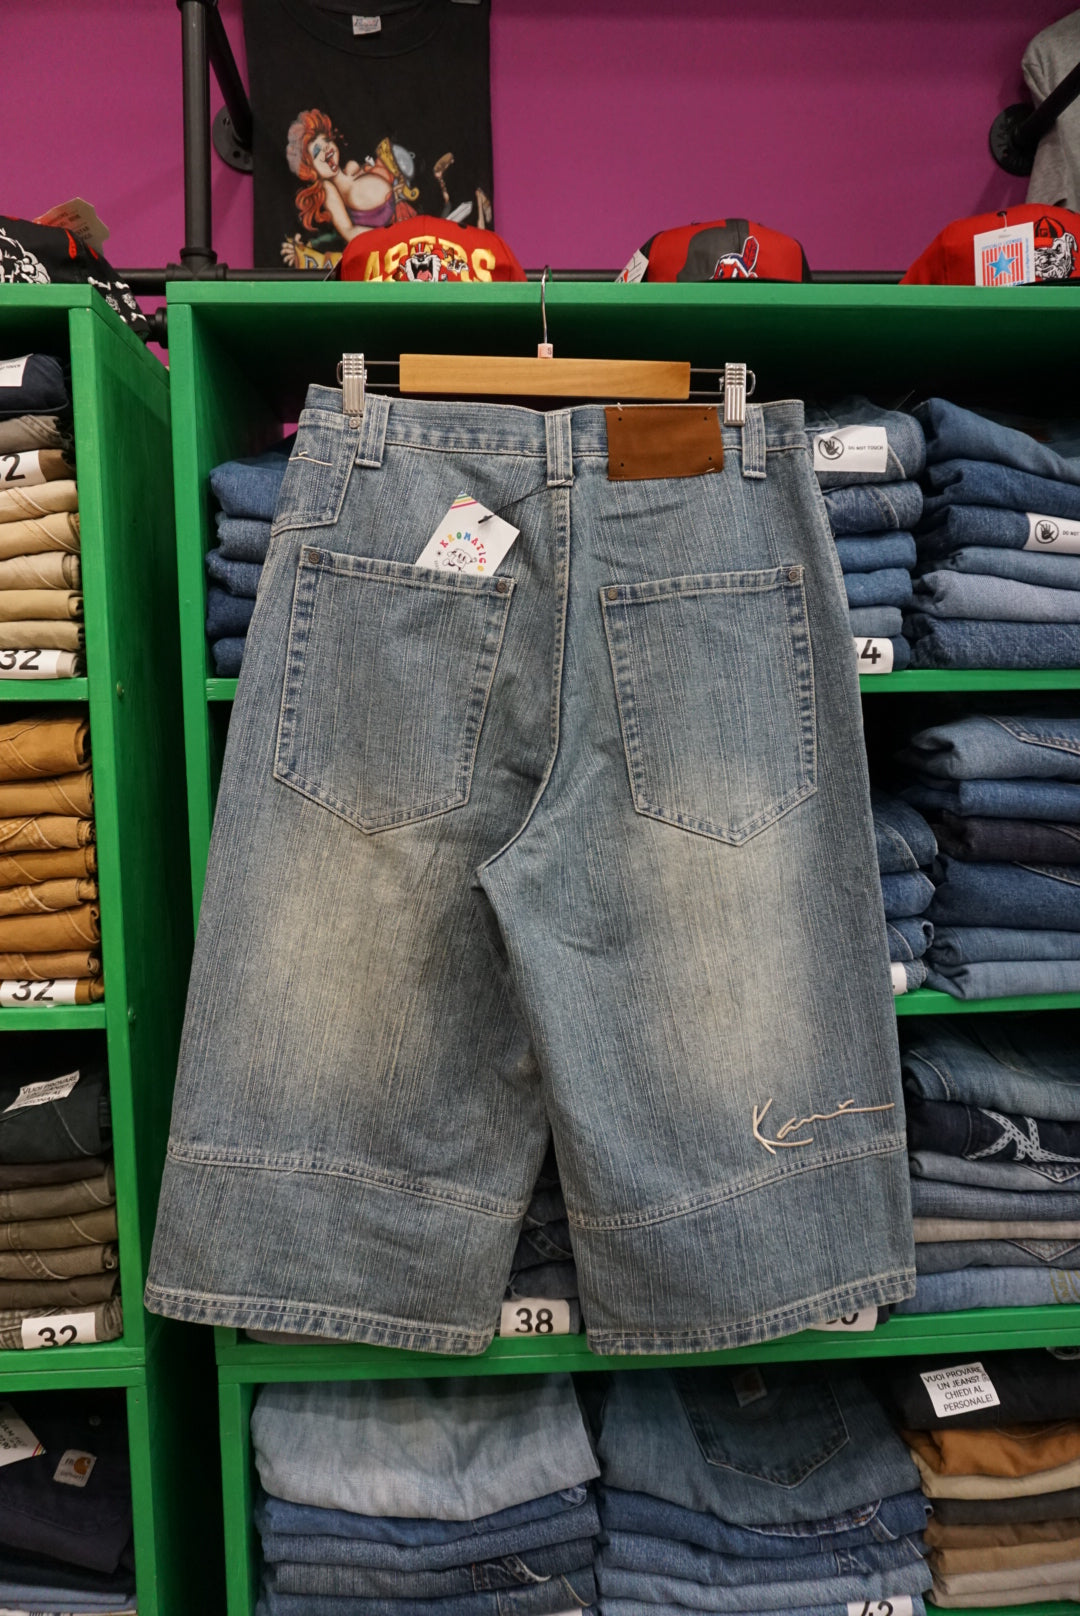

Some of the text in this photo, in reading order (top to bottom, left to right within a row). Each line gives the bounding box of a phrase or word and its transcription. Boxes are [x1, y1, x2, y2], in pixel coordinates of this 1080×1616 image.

[0, 454, 26, 482] 2
[0, 649, 42, 671] 32
[856, 639, 881, 664] 4
[12, 980, 56, 1001] 32
[514, 1307, 554, 1334] 38
[38, 1325, 80, 1347] 32
[923, 1366, 981, 1383] VUOI PROVARE
[937, 1375, 980, 1391] UN JEANS?
[943, 1393, 994, 1412] PERSONALE!
[944, 1385, 985, 1400] CHIEDI AL
